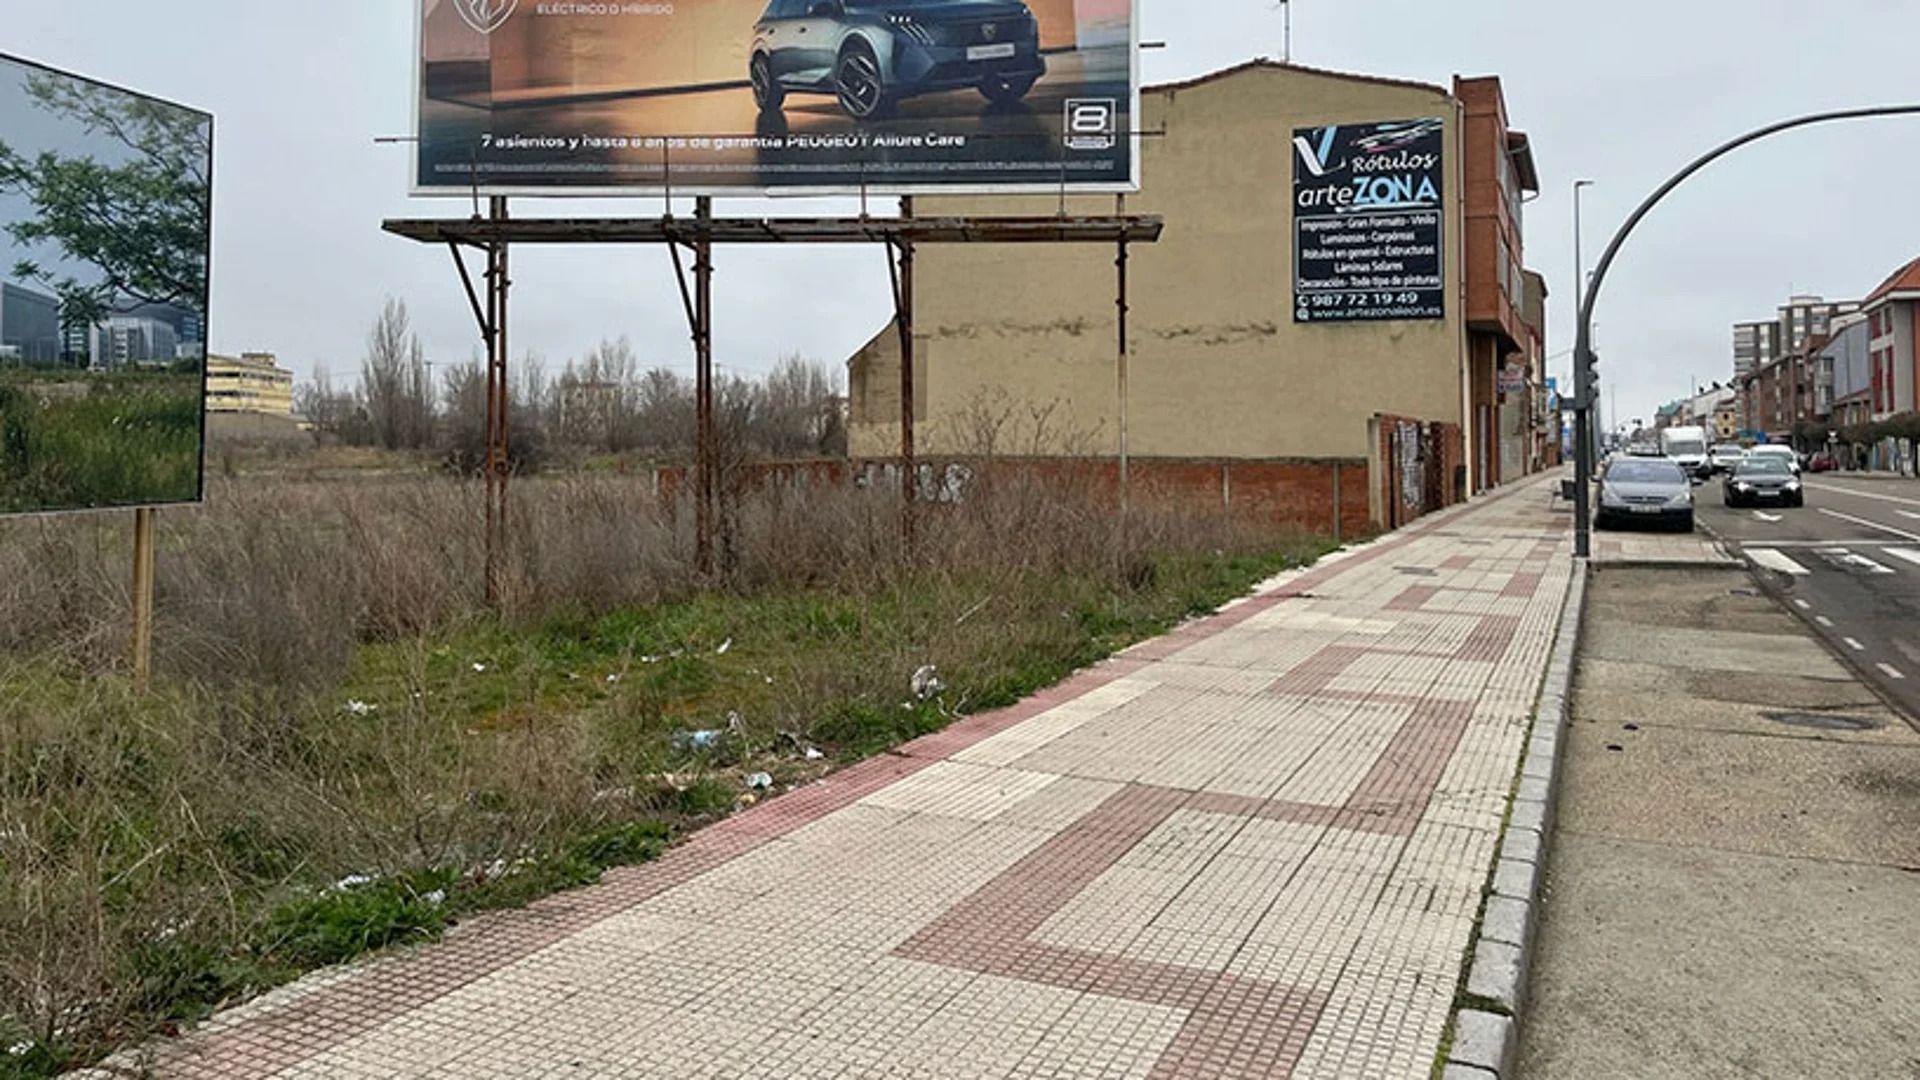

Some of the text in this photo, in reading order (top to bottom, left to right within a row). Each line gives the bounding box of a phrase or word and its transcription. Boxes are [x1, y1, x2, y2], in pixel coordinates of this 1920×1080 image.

[609, 4, 620, 15] O
[482, 134, 492, 147] 7
[495, 134, 566, 148] asientos
[568, 137, 579, 150] y
[583, 134, 627, 147] hasta
[690, 134, 710, 148] de
[713, 133, 782, 150] garantía
[786, 132, 869, 148] PEUGEOT
[872, 131, 922, 147] Allure
[925, 130, 965, 146] Care
[1352, 150, 1438, 173] Rótulos
[1348, 217, 1367, 229] Gran
[1369, 216, 1405, 228] Formato
[1410, 214, 1436, 225] Vinilo
[1320, 233, 1365, 244] Luminosos
[1348, 246, 1379, 260] general
[1385, 245, 1435, 257] Estructuras
[1371, 260, 1403, 272] Solares
[1403, 274, 1441, 287] pinturas
[1312, 291, 1418, 306] 987 72 19 49
